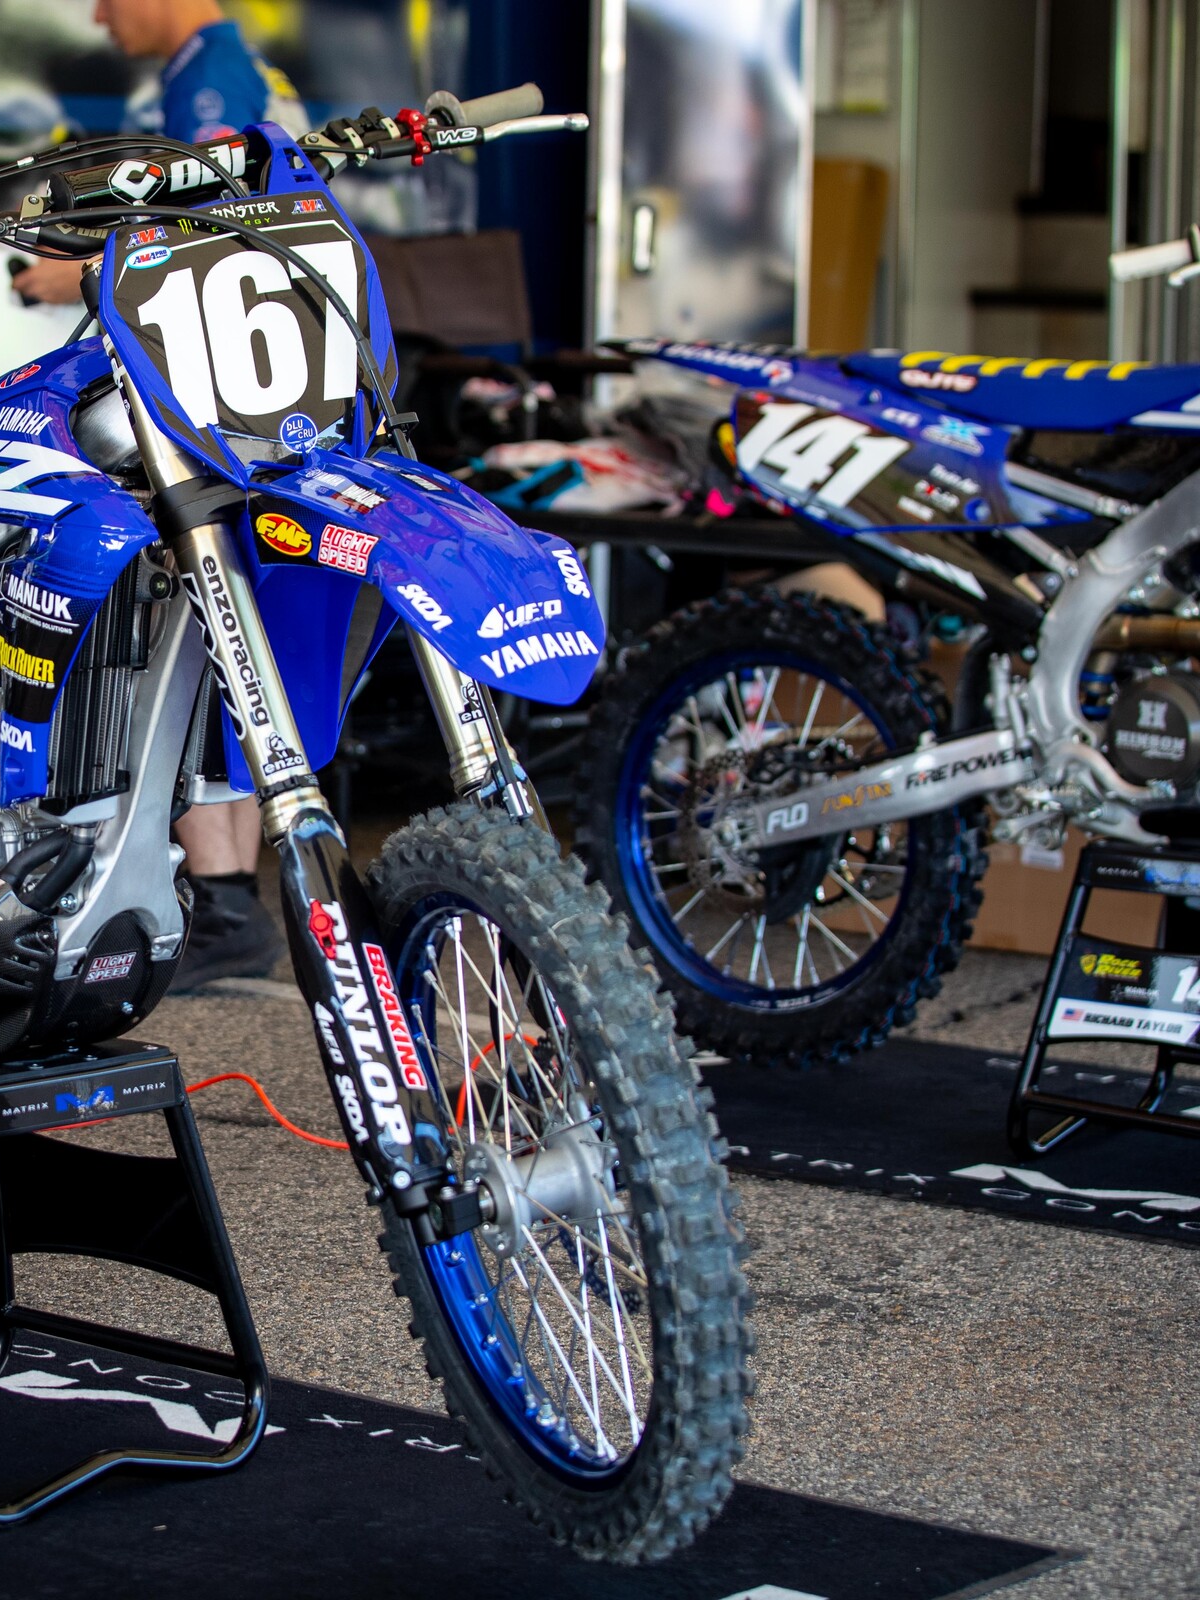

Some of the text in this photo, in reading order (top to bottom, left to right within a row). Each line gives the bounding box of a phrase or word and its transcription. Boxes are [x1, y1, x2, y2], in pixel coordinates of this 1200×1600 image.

[194, 202, 280, 224] NSTER
[292, 199, 327, 214] AMA
[126, 225, 169, 249] AMA
[211, 217, 271, 234] ERGY
[137, 240, 358, 429] 167
[737, 401, 911, 509] 141
[257, 516, 312, 549] FMF
[321, 525, 378, 555] LIGHT
[318, 545, 369, 574] SPEED
[7, 574, 72, 621] MANLUK
[504, 599, 563, 629] UFO
[202, 555, 238, 632] enzo
[229, 634, 270, 727] racing
[480, 630, 599, 679] YAMAHA
[264, 757, 305, 775] enzo
[86, 965, 130, 982] SPEED
[92, 953, 137, 969] LIGHT
[319, 900, 412, 1146] DUNLOP
[363, 943, 428, 1090] BRAKING
[1083, 1012, 1183, 1034] RICHARD TAYLOR
[1, 1101, 50, 1117] MATRIX
[122, 1081, 167, 1095] MATRIX
